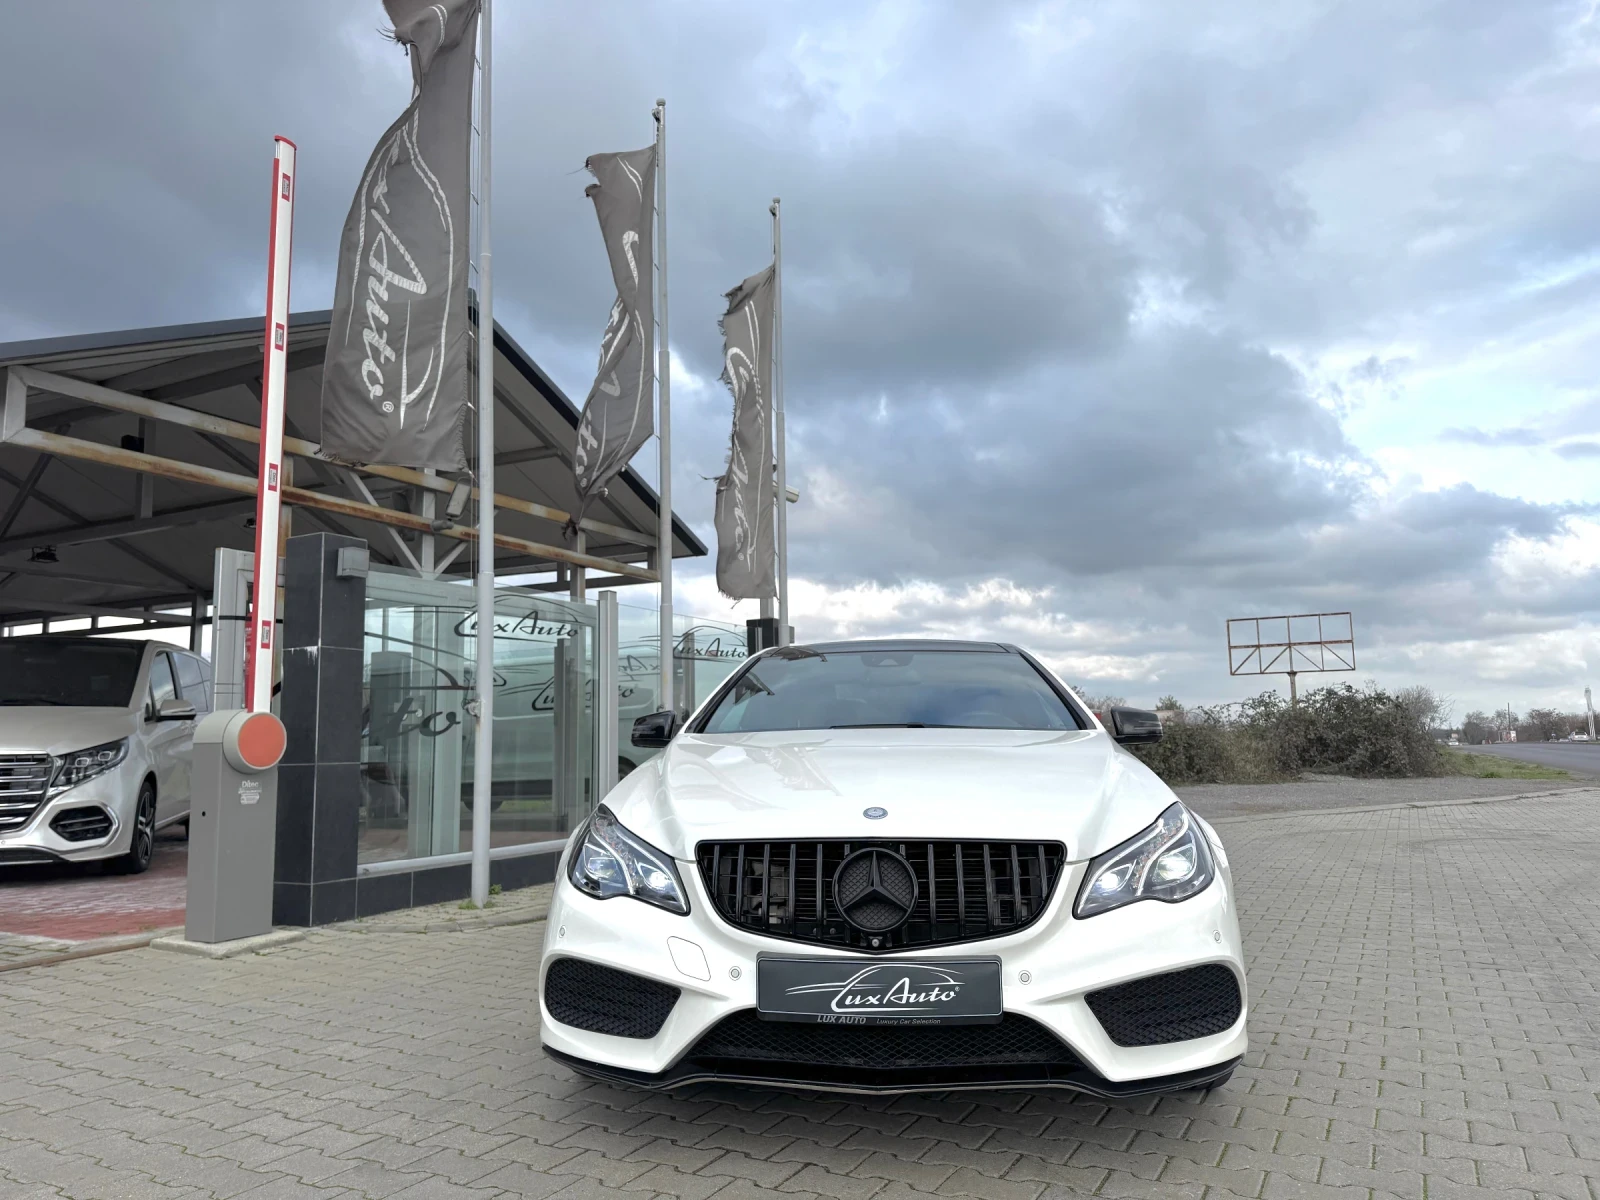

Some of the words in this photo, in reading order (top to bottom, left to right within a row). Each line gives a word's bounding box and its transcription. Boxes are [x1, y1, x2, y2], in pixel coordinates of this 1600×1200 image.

[817, 1014, 836, 1024] LUX
[839, 1016, 867, 1025] AUTO
[876, 1018, 898, 1026] Luxury
